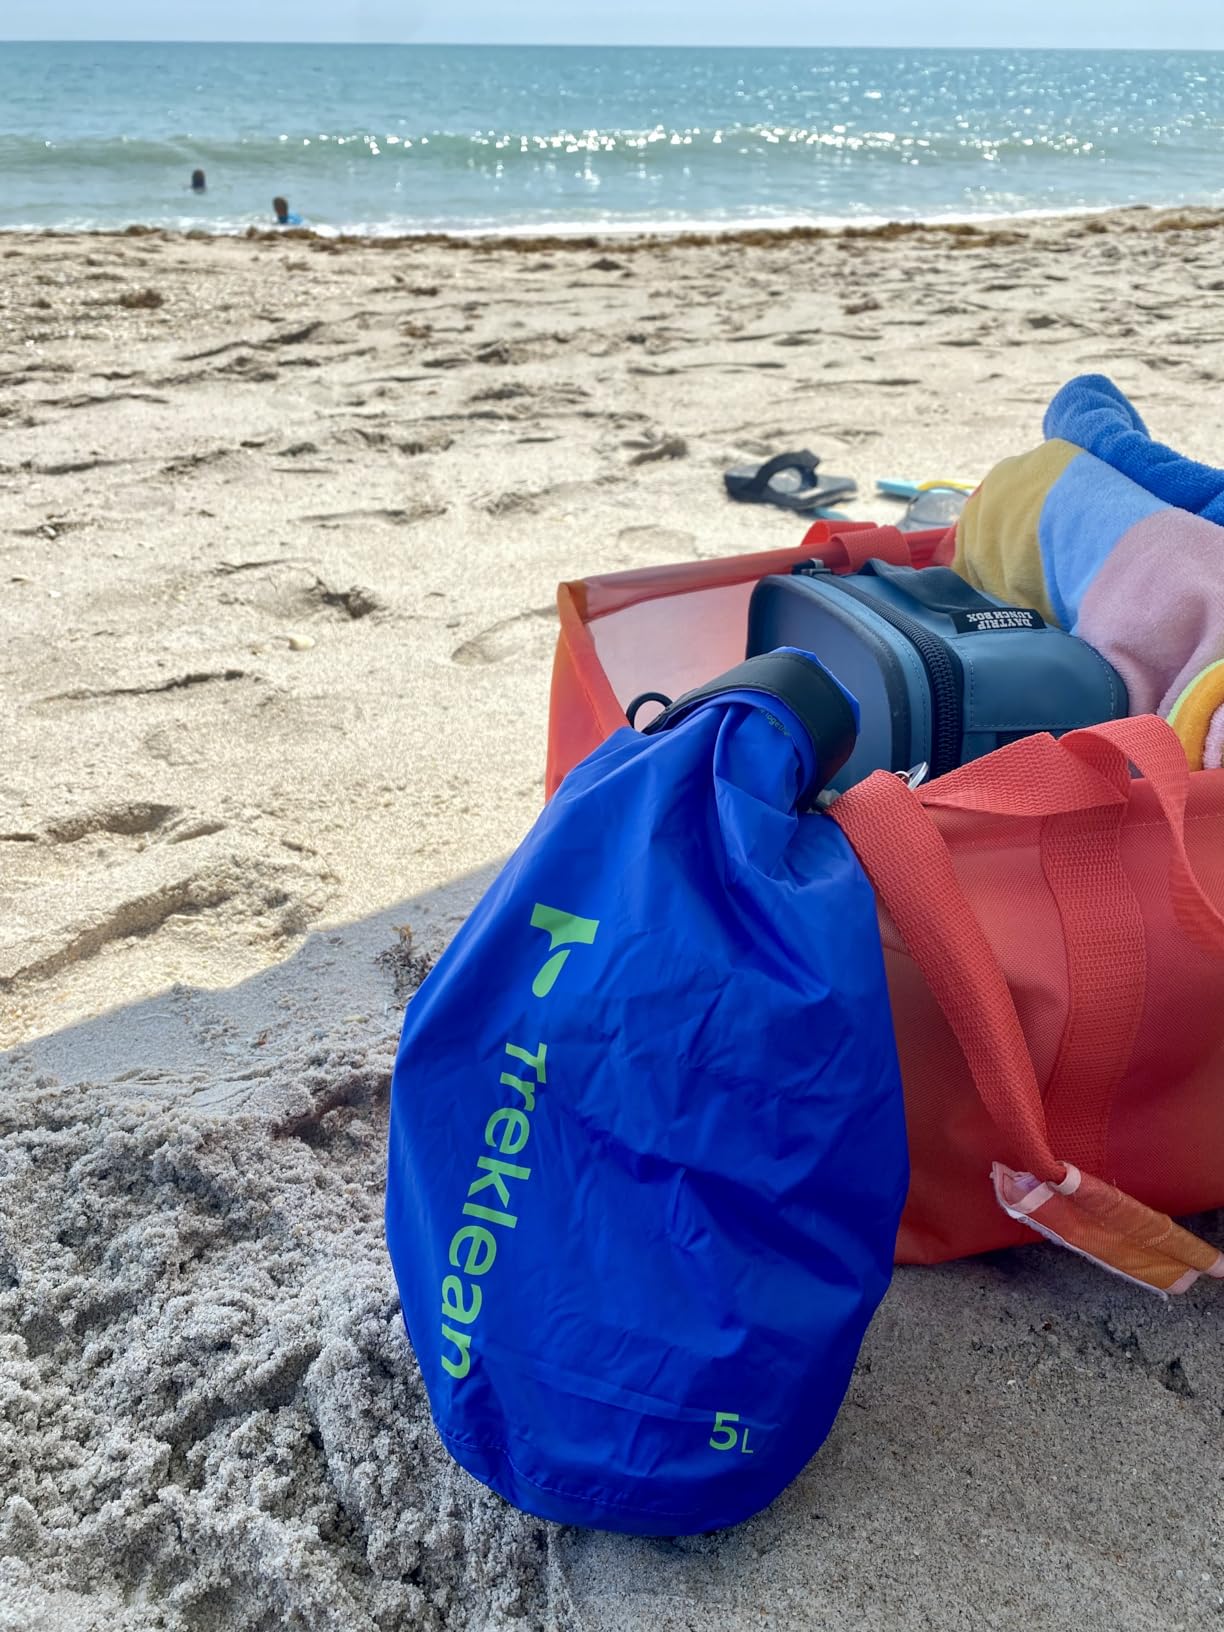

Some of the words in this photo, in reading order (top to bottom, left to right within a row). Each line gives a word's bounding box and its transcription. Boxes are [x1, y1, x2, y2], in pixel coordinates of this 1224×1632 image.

[966, 611, 993, 623] BOX
[992, 611, 1034, 620] LUNCH
[977, 618, 1033, 630] DAYTRIP
[441, 1042, 547, 1378] Treklean
